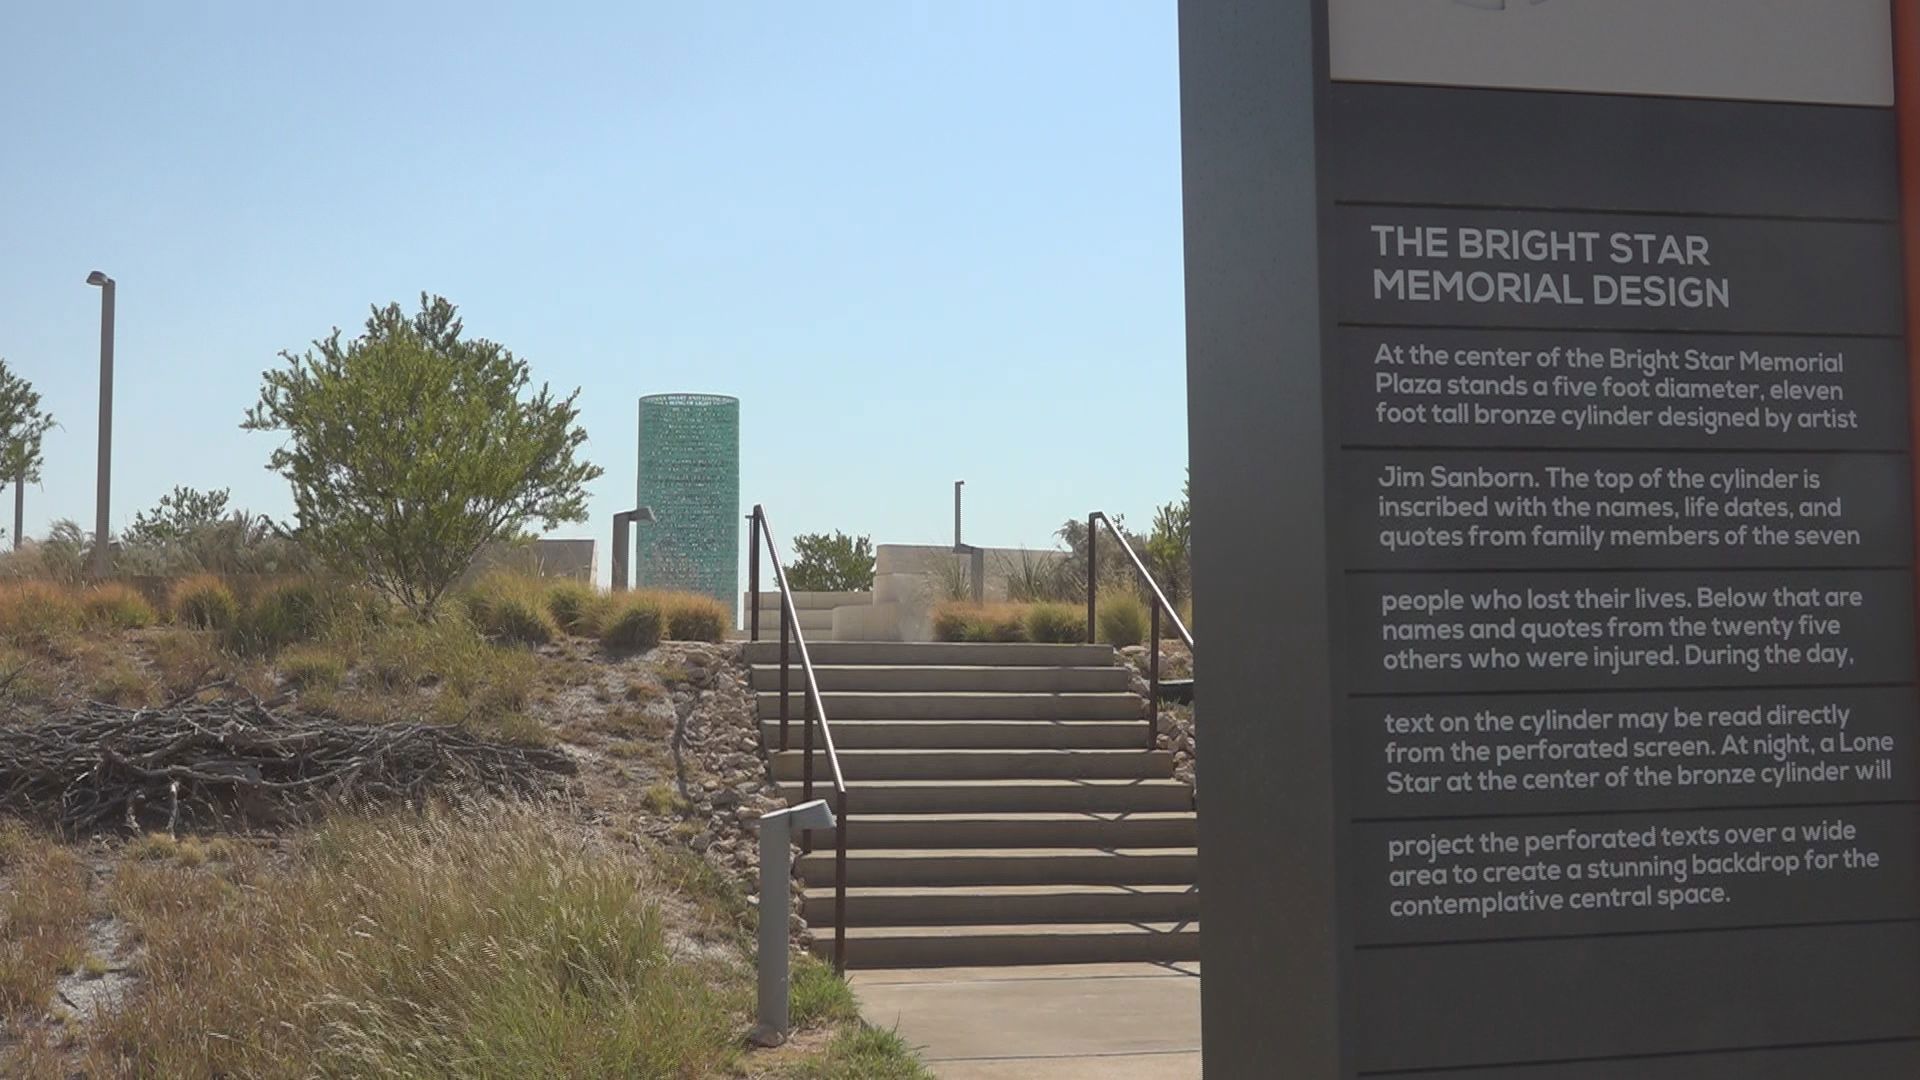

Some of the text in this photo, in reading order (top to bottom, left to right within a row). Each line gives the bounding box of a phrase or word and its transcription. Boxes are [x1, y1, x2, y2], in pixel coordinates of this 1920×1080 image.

[1371, 226, 1709, 265] THE BRIGHT STAR
[1374, 269, 1728, 307] MEMORIAL DESIGN
[1375, 344, 1842, 376] At the center of the Bright Star Memorial
[1377, 373, 1842, 400] Plaza stands a five foot diameter, eleven
[1376, 402, 1857, 434] foot tall bronze cylinder designed by artist
[1379, 466, 1820, 493] Jim Sanborn. The top of the cylinder is
[1380, 496, 1841, 518] inscribed with the names, life dates, and
[1380, 525, 1859, 551] quotes from family members of the seven
[1383, 587, 1862, 615] people who lost their lives. Below that are
[1384, 615, 1840, 643] names and quotes from the twenty five
[1384, 643, 1853, 674] others who were injured. During the day,
[1385, 704, 1849, 735] text on the cylinder may be read directly
[1386, 732, 1893, 765] from the perforated screen. At night, a Lone
[1388, 760, 1890, 792] Star at the center of the bronze cylinder will
[1389, 820, 1855, 862] project the perforated texts over a wide
[1390, 848, 1878, 886] area to create a stunning backdrop for the
[1391, 886, 1729, 917] contemplative central space.
